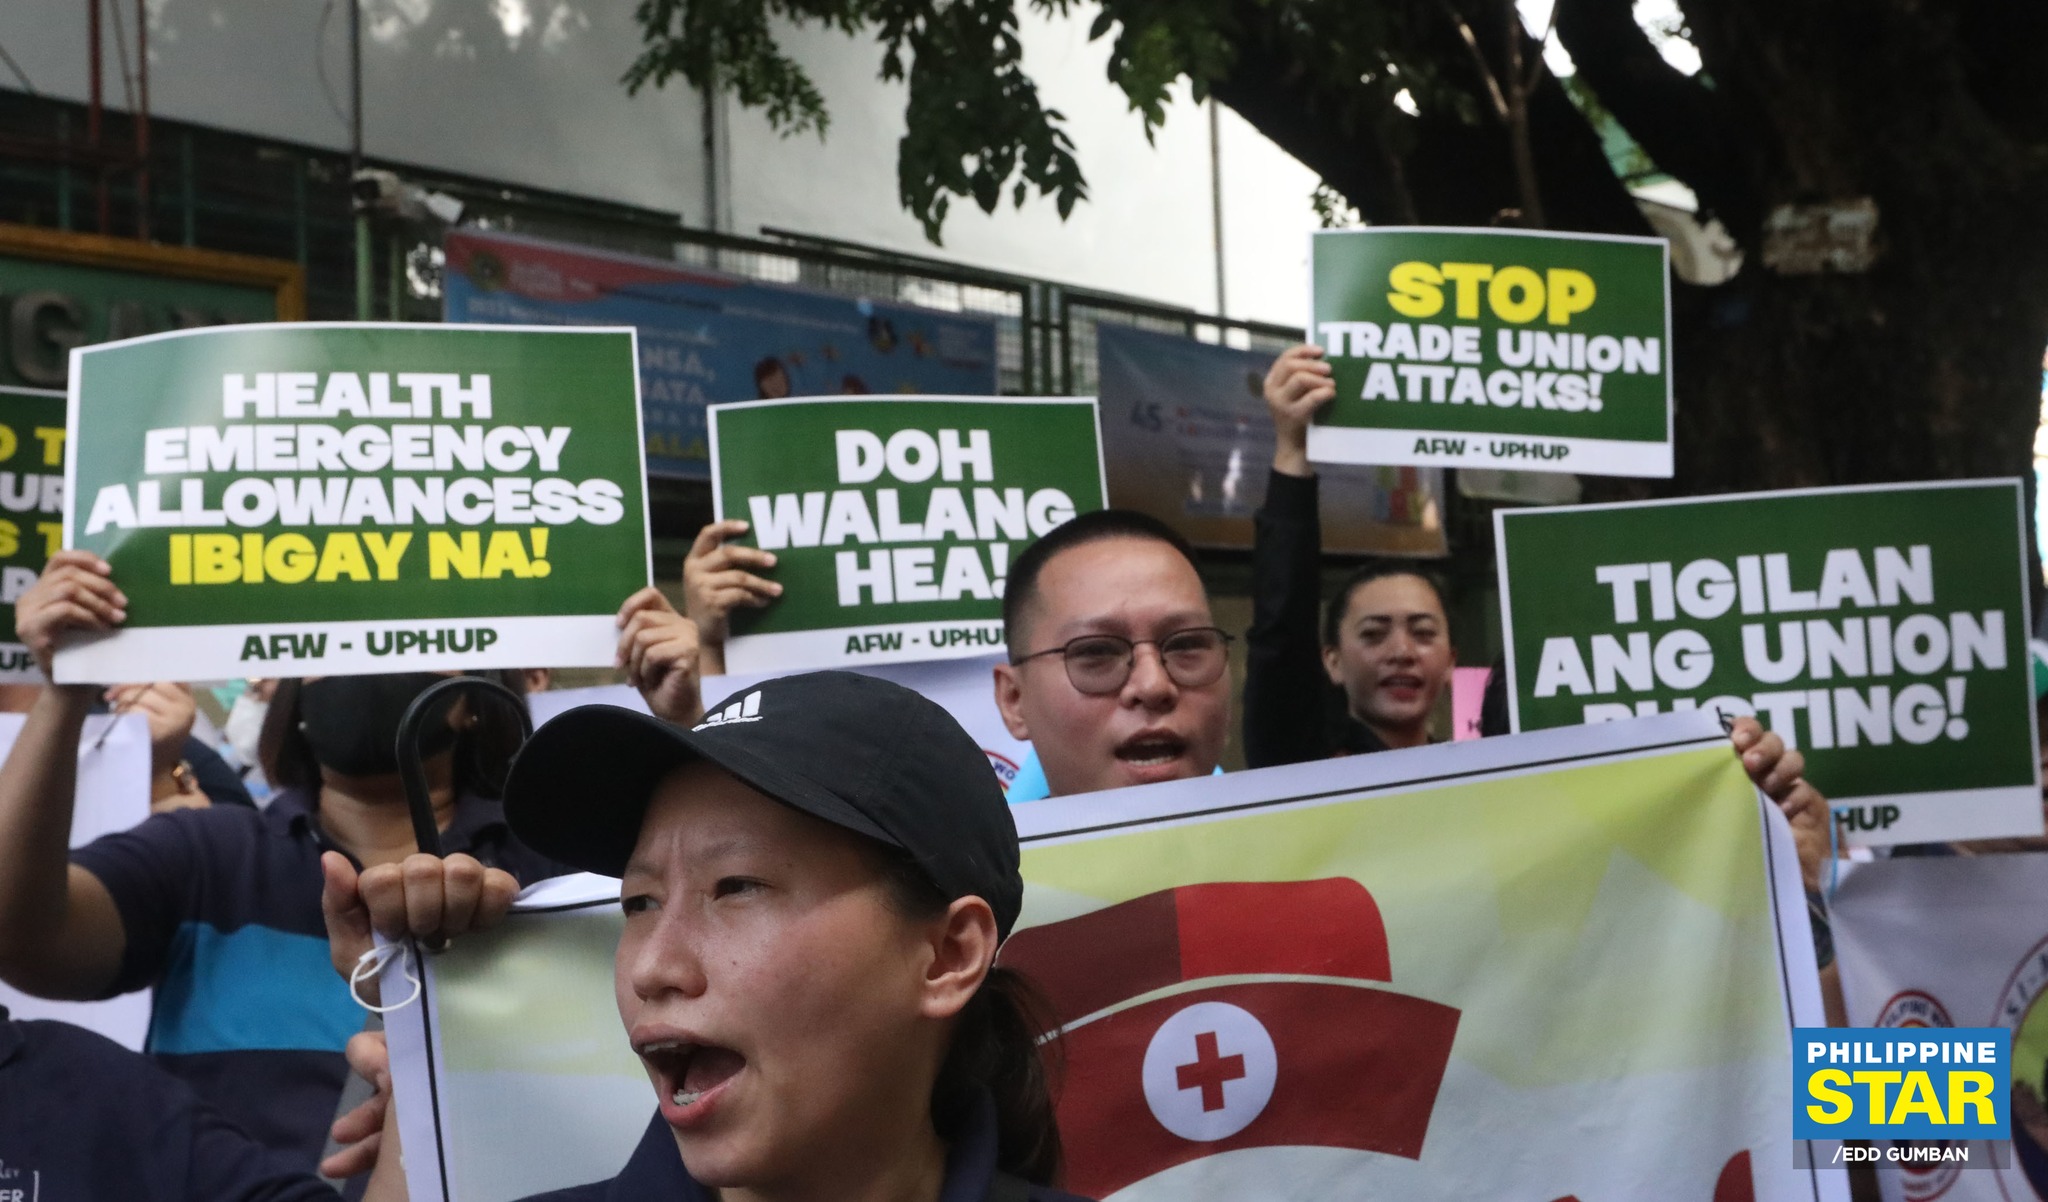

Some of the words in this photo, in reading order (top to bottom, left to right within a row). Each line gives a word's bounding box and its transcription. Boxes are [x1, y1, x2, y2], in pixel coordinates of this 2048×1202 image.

[1387, 261, 1597, 325] STOP
[1319, 321, 1483, 364] TRADE
[1497, 328, 1661, 376] UNION
[222, 372, 492, 420] HEALTH
[1361, 362, 1604, 413] ATTACKS!
[144, 424, 572, 476] EMERGENCY
[835, 428, 994, 484] DOH
[1413, 437, 1466, 457] AFW
[1489, 439, 1570, 461] UPHUP
[85, 477, 624, 536] ALLOWANCESS
[748, 487, 1077, 550] WALANG
[169, 531, 413, 587] IBIGAY
[429, 527, 552, 580] NA!
[835, 542, 1010, 607] HEA!
[1595, 544, 1934, 624] TIGILAN
[240, 632, 327, 662] AFW
[366, 627, 498, 656] UPHUP
[845, 632, 903, 655] AFW
[1533, 628, 1714, 698] ANG
[1742, 609, 2008, 684] UNION
